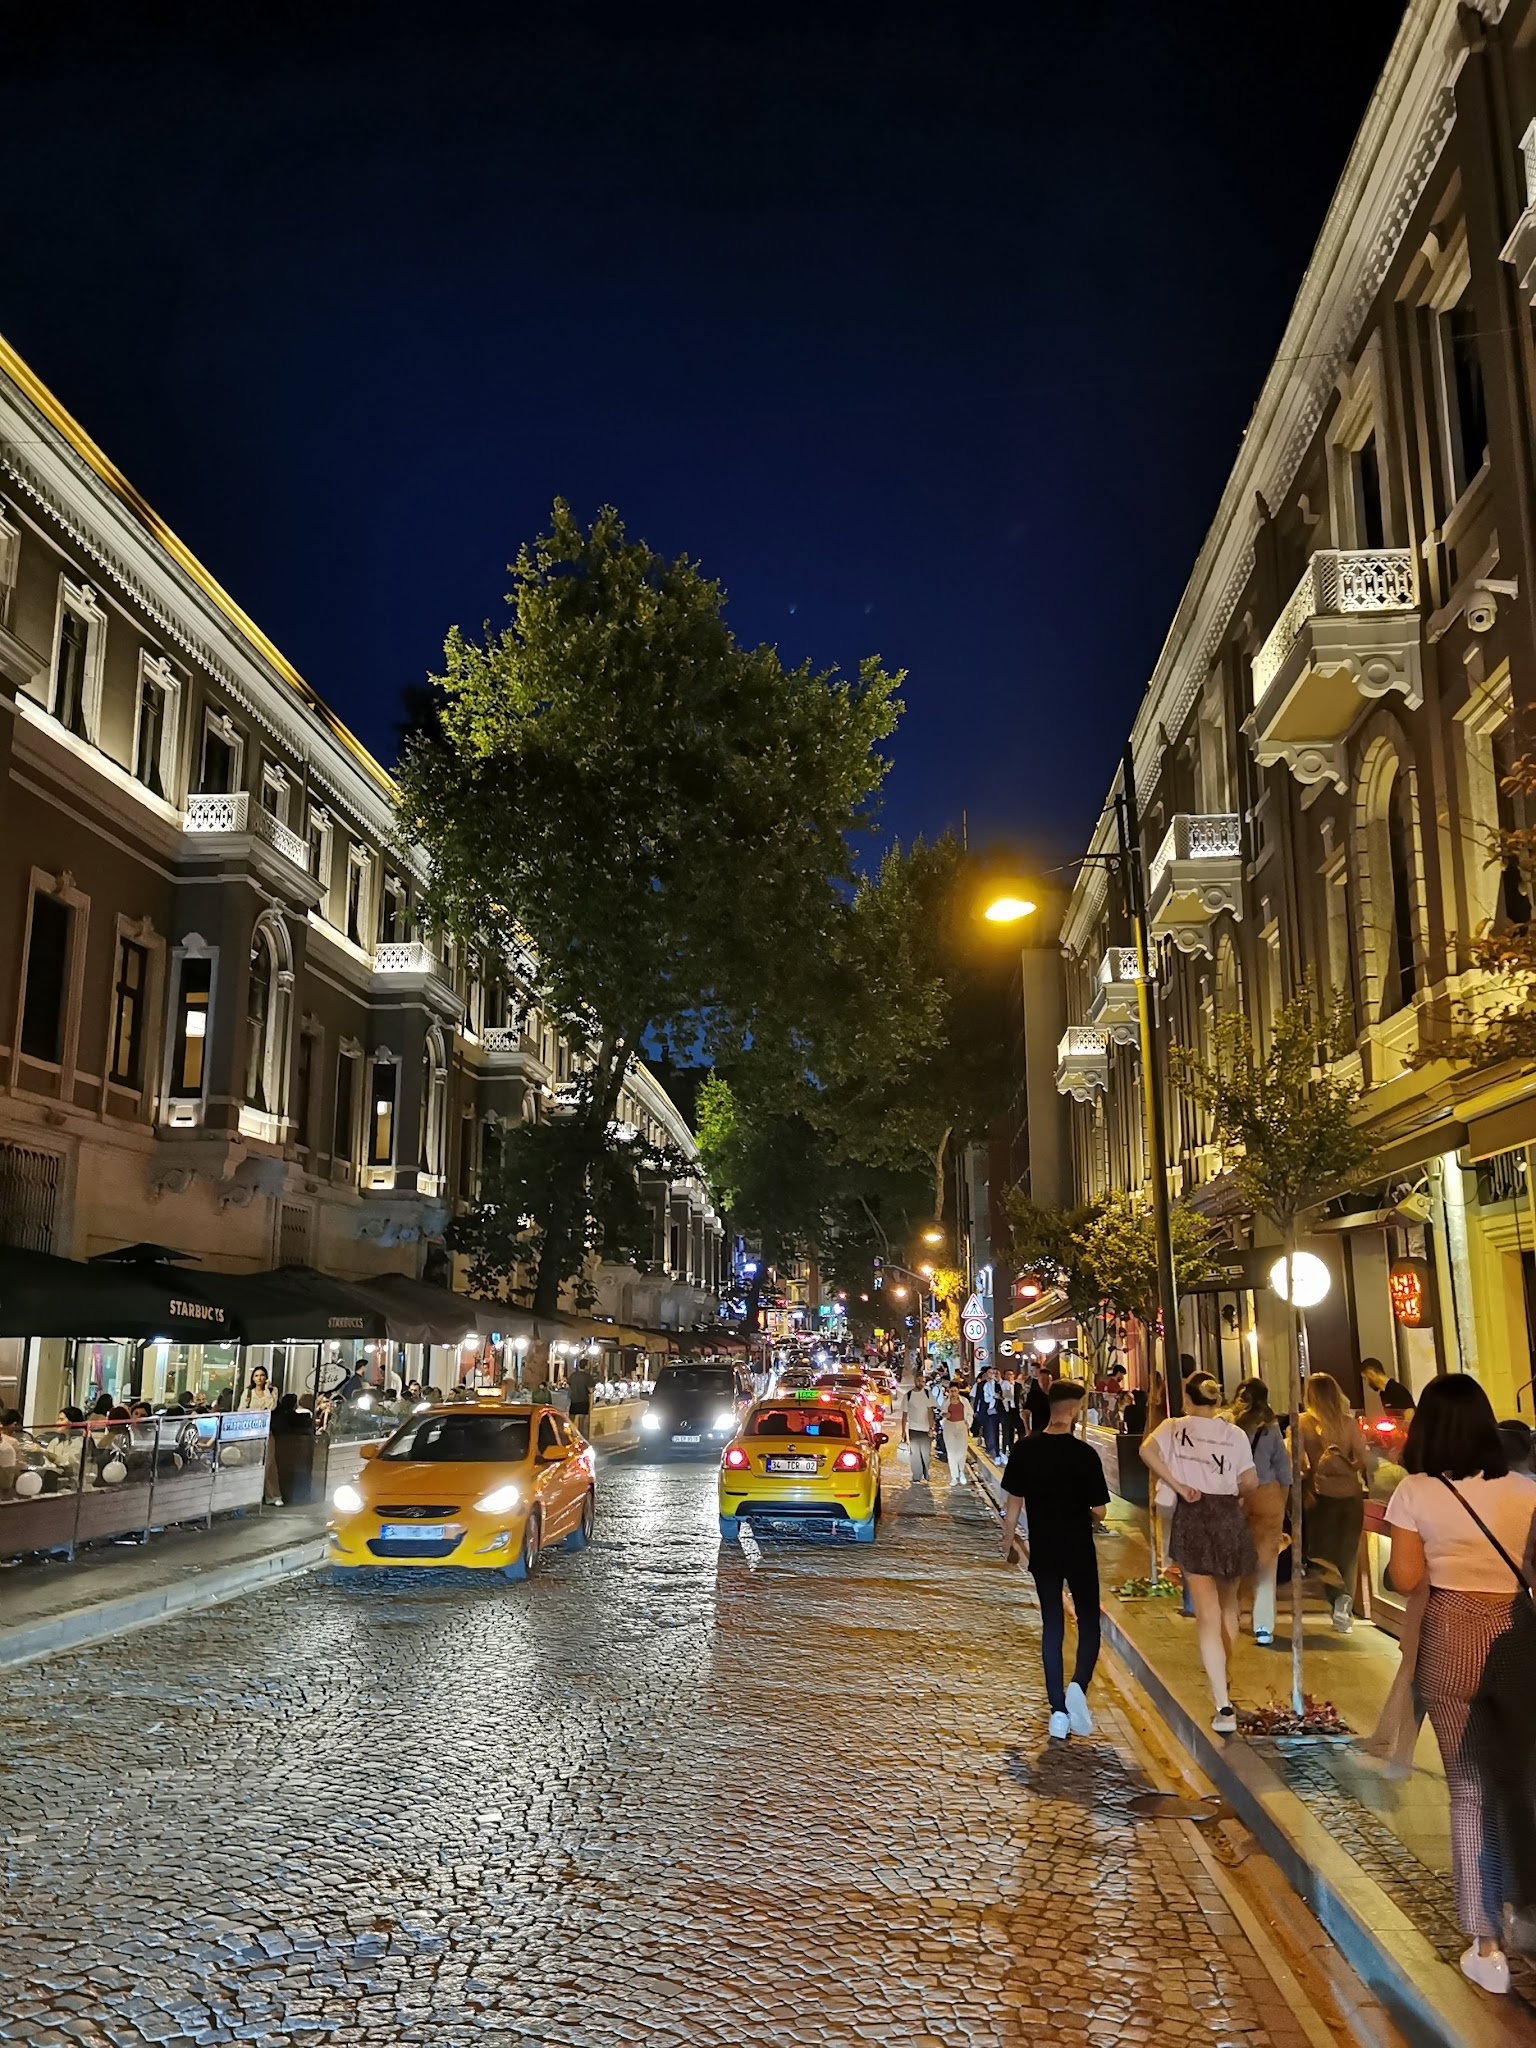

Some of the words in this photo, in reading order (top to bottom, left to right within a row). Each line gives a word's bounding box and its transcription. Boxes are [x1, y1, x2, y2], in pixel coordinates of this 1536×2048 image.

[969, 1325, 981, 1335] 30
[772, 1461, 781, 1469] 34
[787, 1462, 800, 1470] TCR
[806, 1462, 815, 1470] 02
